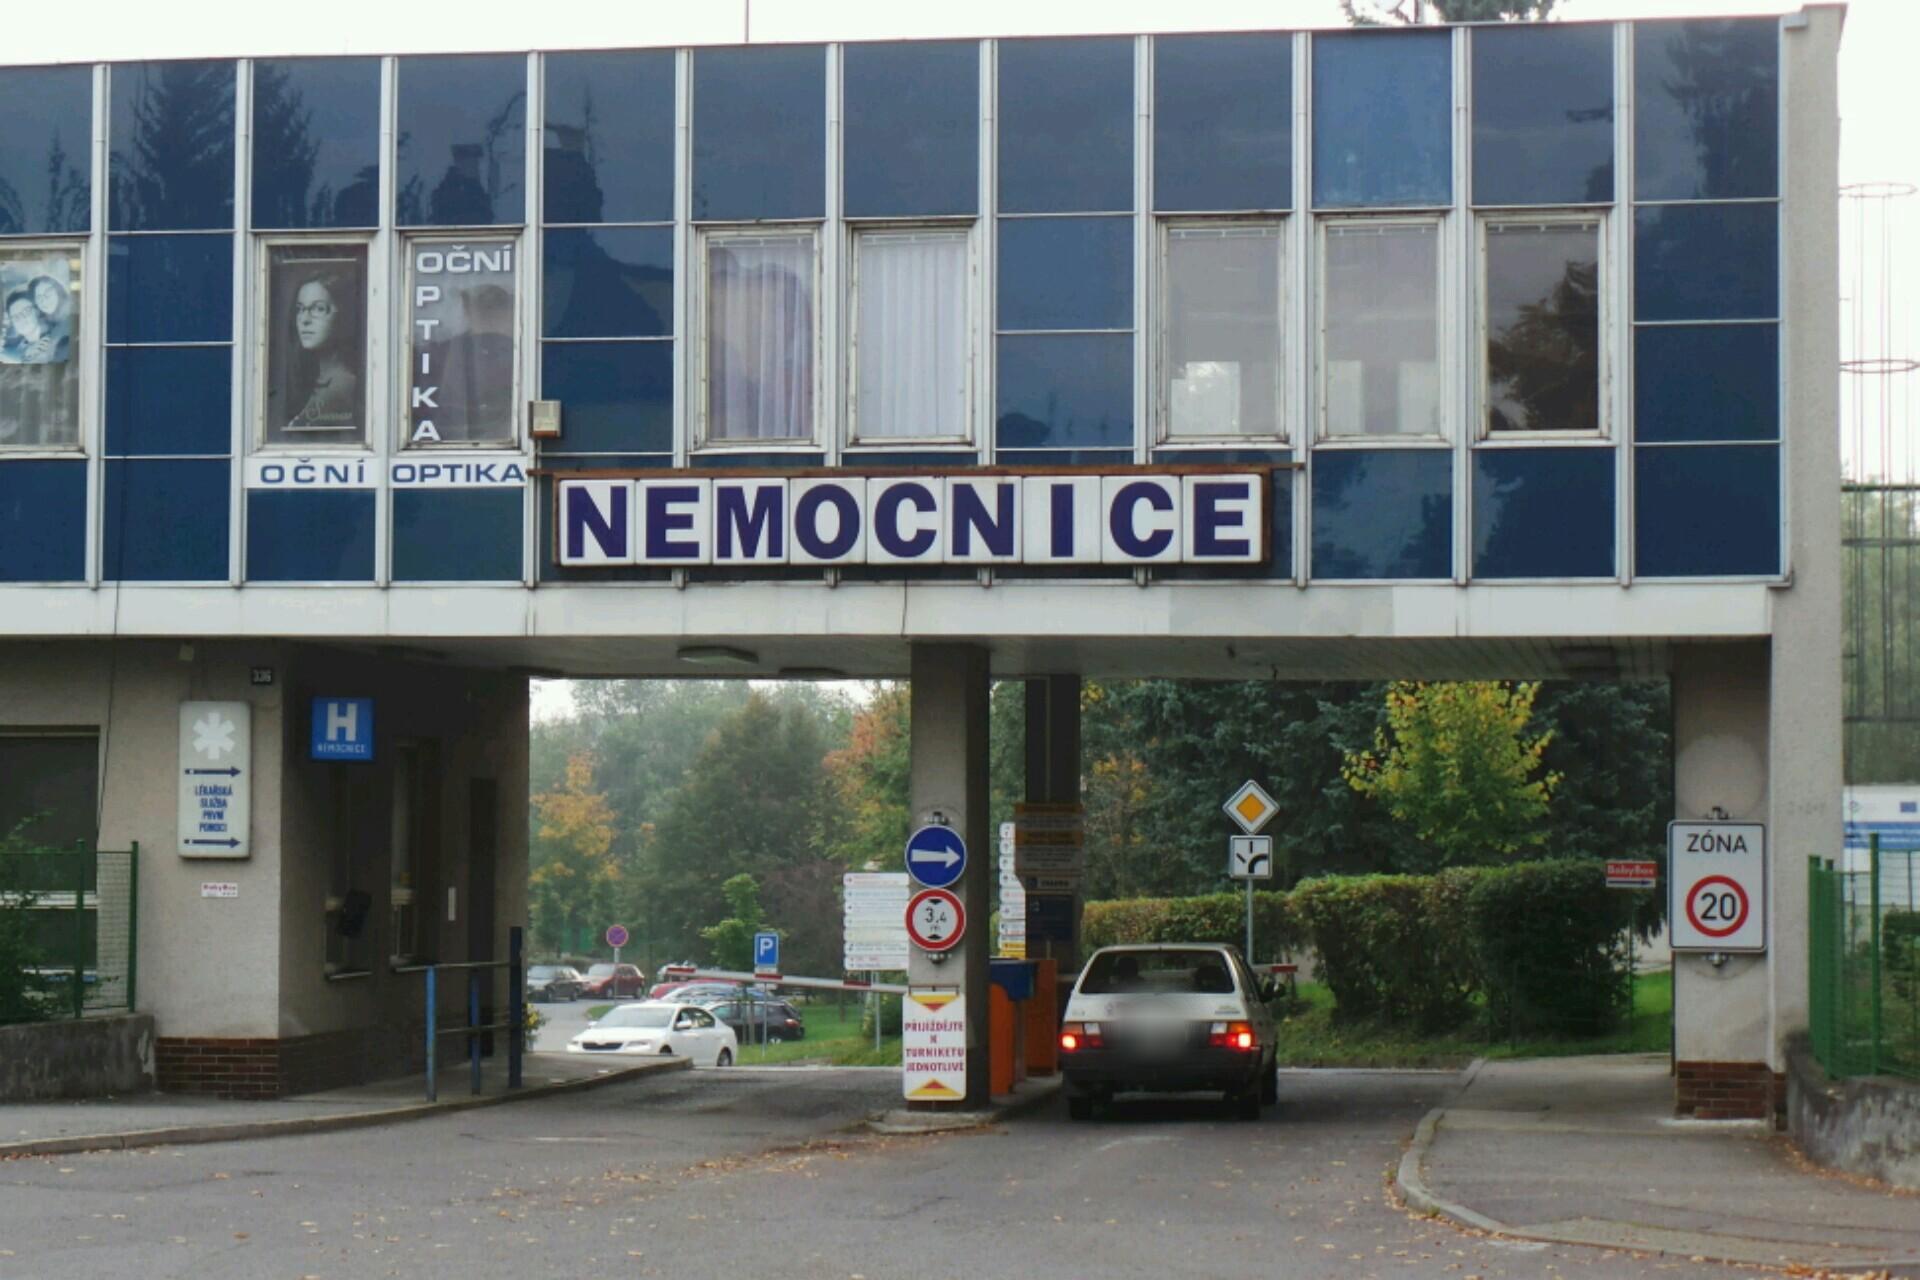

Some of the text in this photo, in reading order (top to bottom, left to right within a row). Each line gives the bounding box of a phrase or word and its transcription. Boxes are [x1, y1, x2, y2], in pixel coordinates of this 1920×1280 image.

[416, 245, 511, 273] OČNÍ
[260, 457, 526, 483] OČNÍ OPTIKA
[567, 481, 1251, 559] NEMOCNICE
[327, 703, 358, 741] H
[1687, 829, 1748, 853] ZÓNA
[1701, 892, 1737, 921] 20
[759, 937, 774, 957] P
[905, 1047, 965, 1058] TURNIKETU
